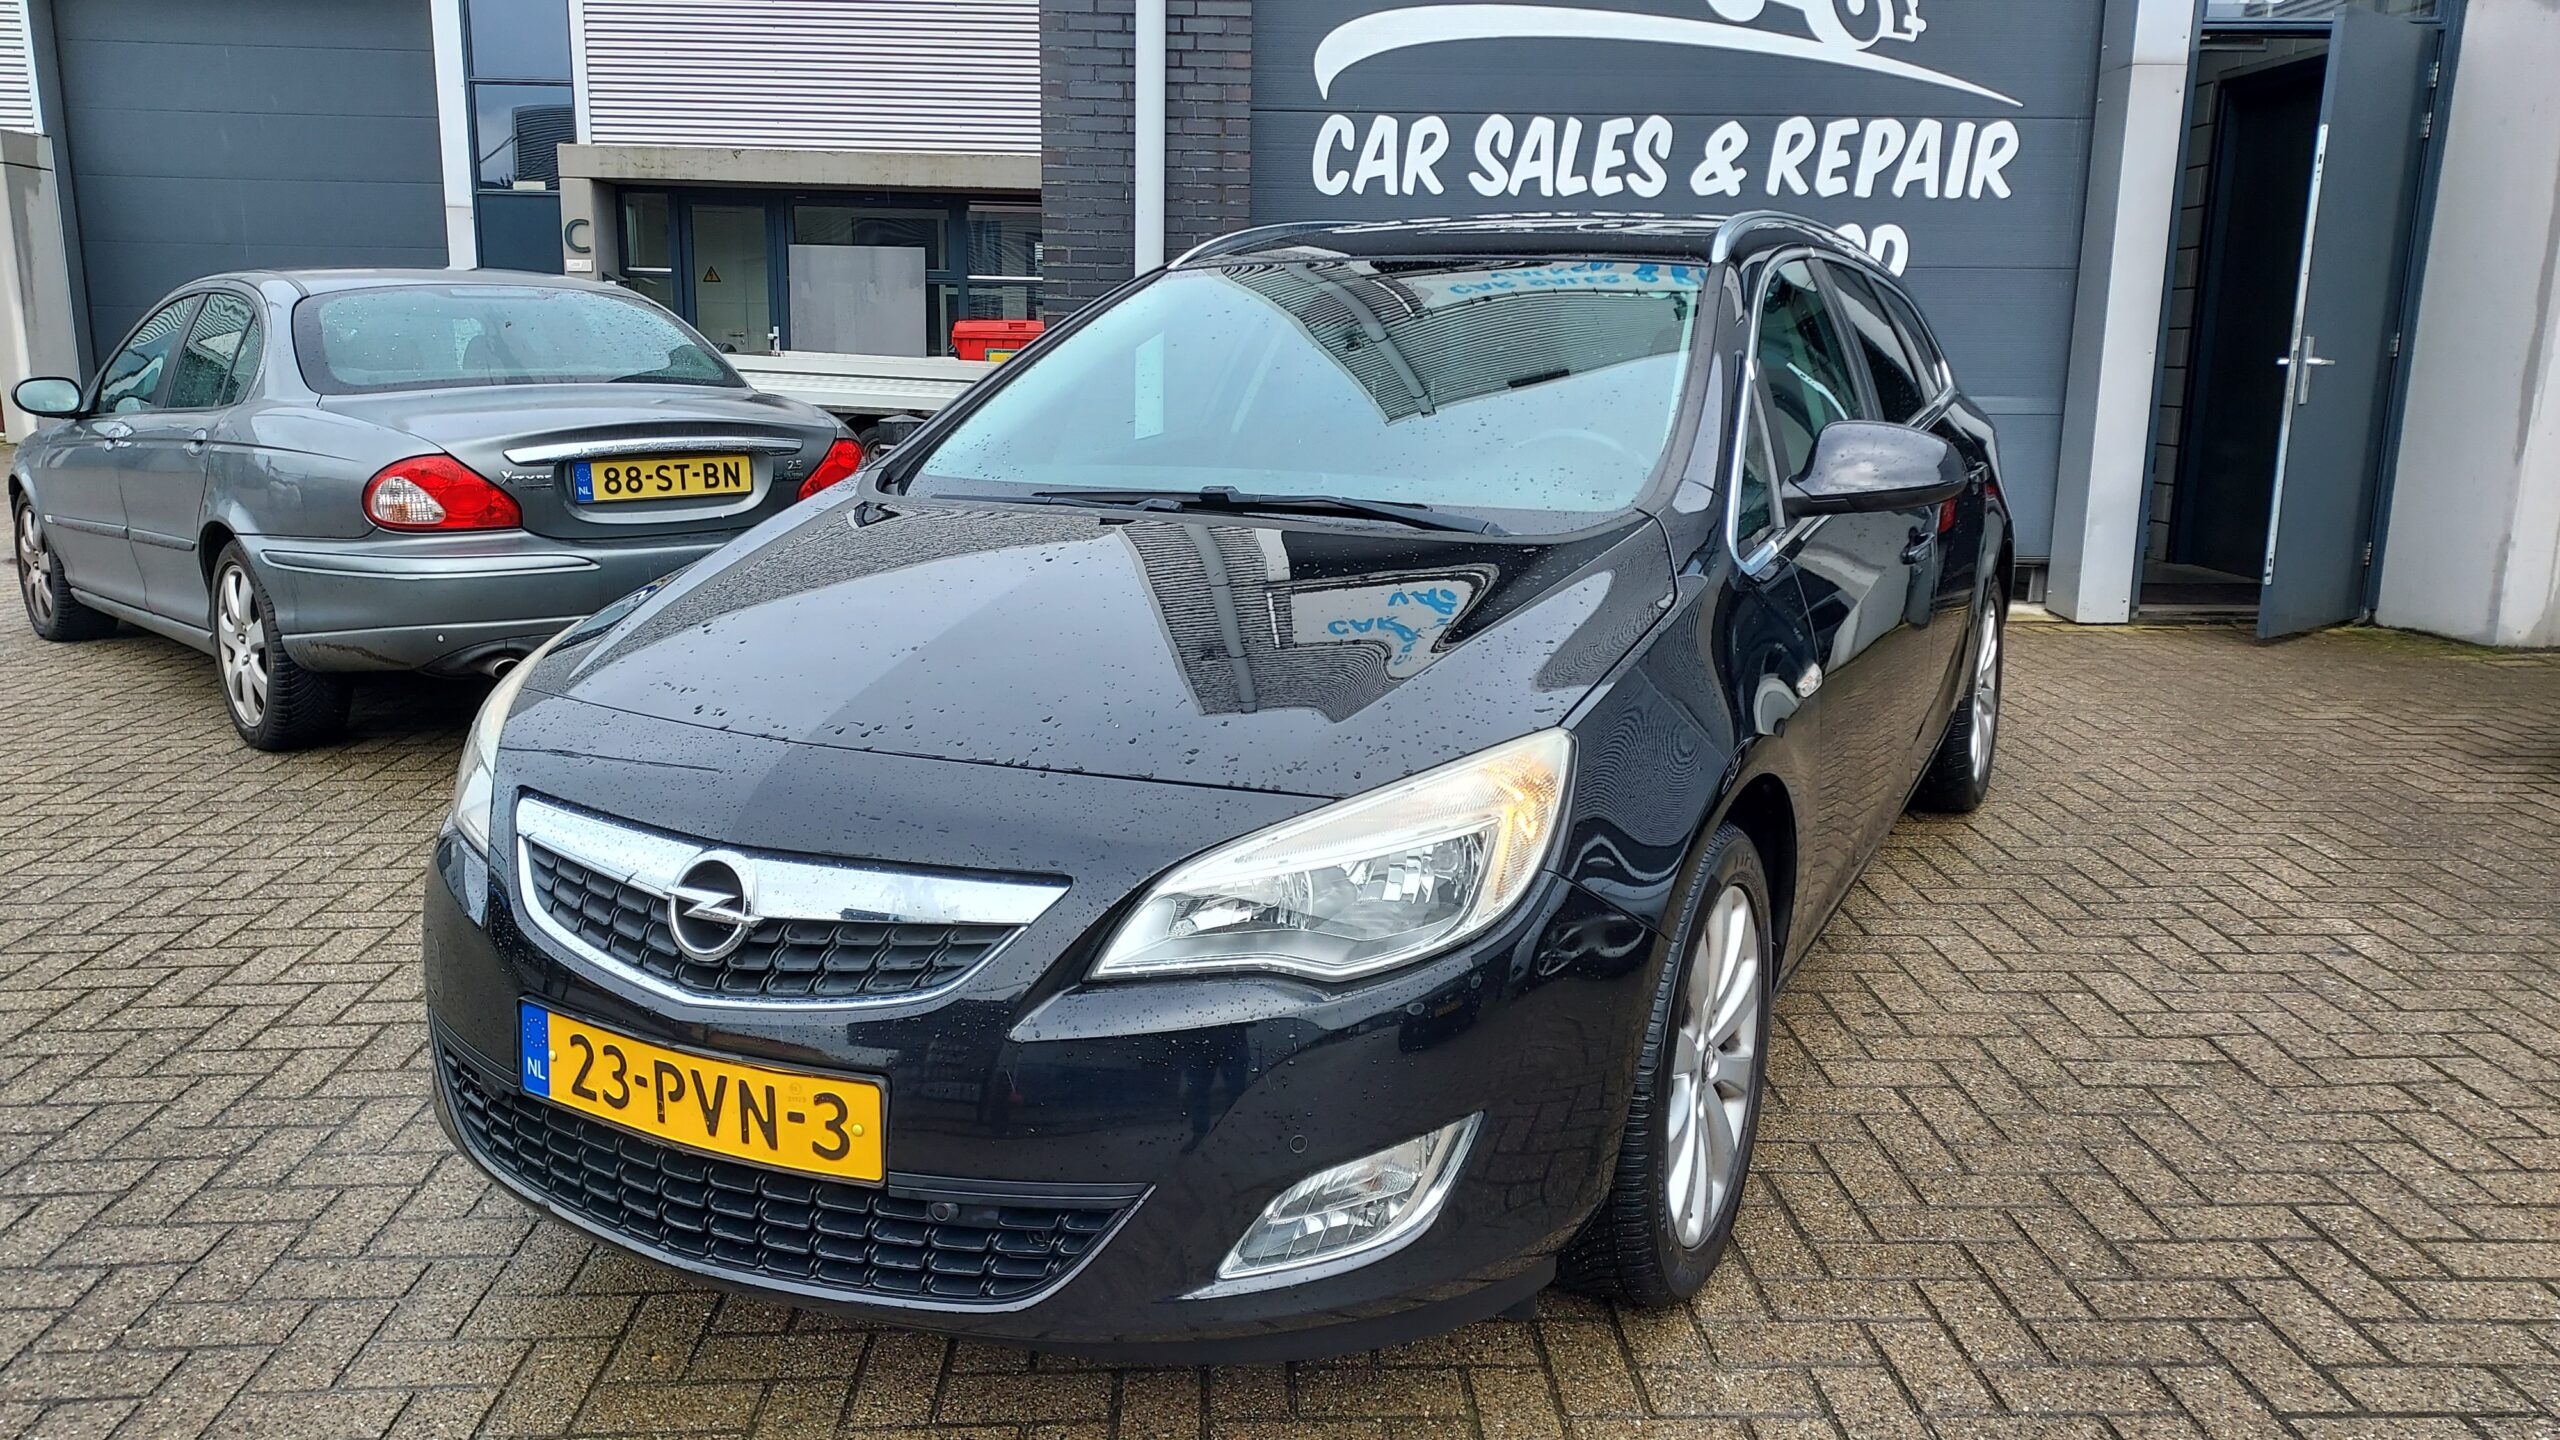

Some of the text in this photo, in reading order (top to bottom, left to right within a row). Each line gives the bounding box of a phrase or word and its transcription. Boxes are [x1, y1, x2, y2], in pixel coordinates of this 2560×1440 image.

[1312, 114, 2020, 200] CAR SALES & REPAIR
[565, 218, 591, 253] C
[578, 461, 741, 497] NL 88-ST-BN
[527, 1033, 851, 1161] NL 23-PVN-3
